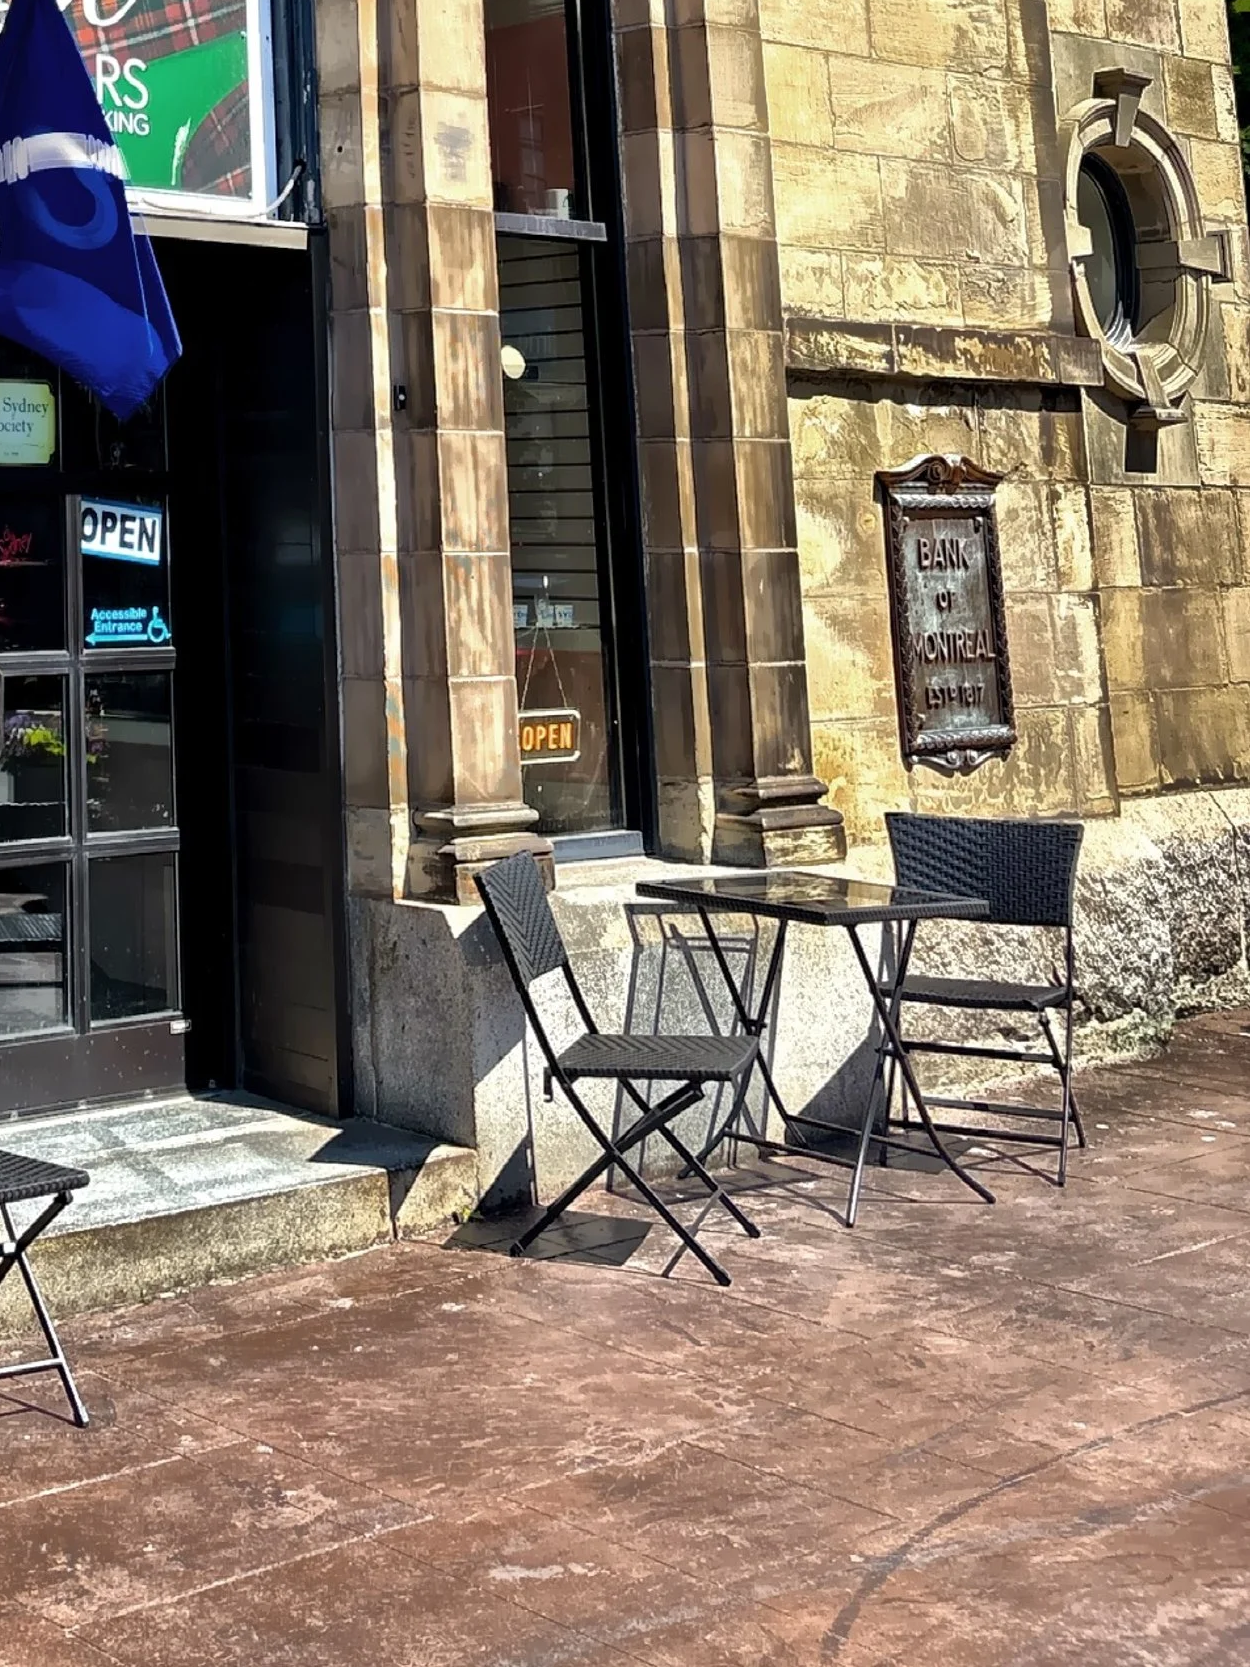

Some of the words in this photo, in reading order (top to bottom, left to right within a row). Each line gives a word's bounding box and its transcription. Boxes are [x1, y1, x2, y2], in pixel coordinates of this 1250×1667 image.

[95, 53, 149, 110] RS
[102, 110, 150, 136] KING
[3, 397, 49, 420] Sydney
[81, 507, 157, 554] OPEN
[917, 537, 970, 571] BANK
[90, 607, 147, 621] Accessible
[93, 619, 143, 633] Entrance
[912, 628, 996, 664] MONTREAL
[521, 721, 573, 751] OPEN
